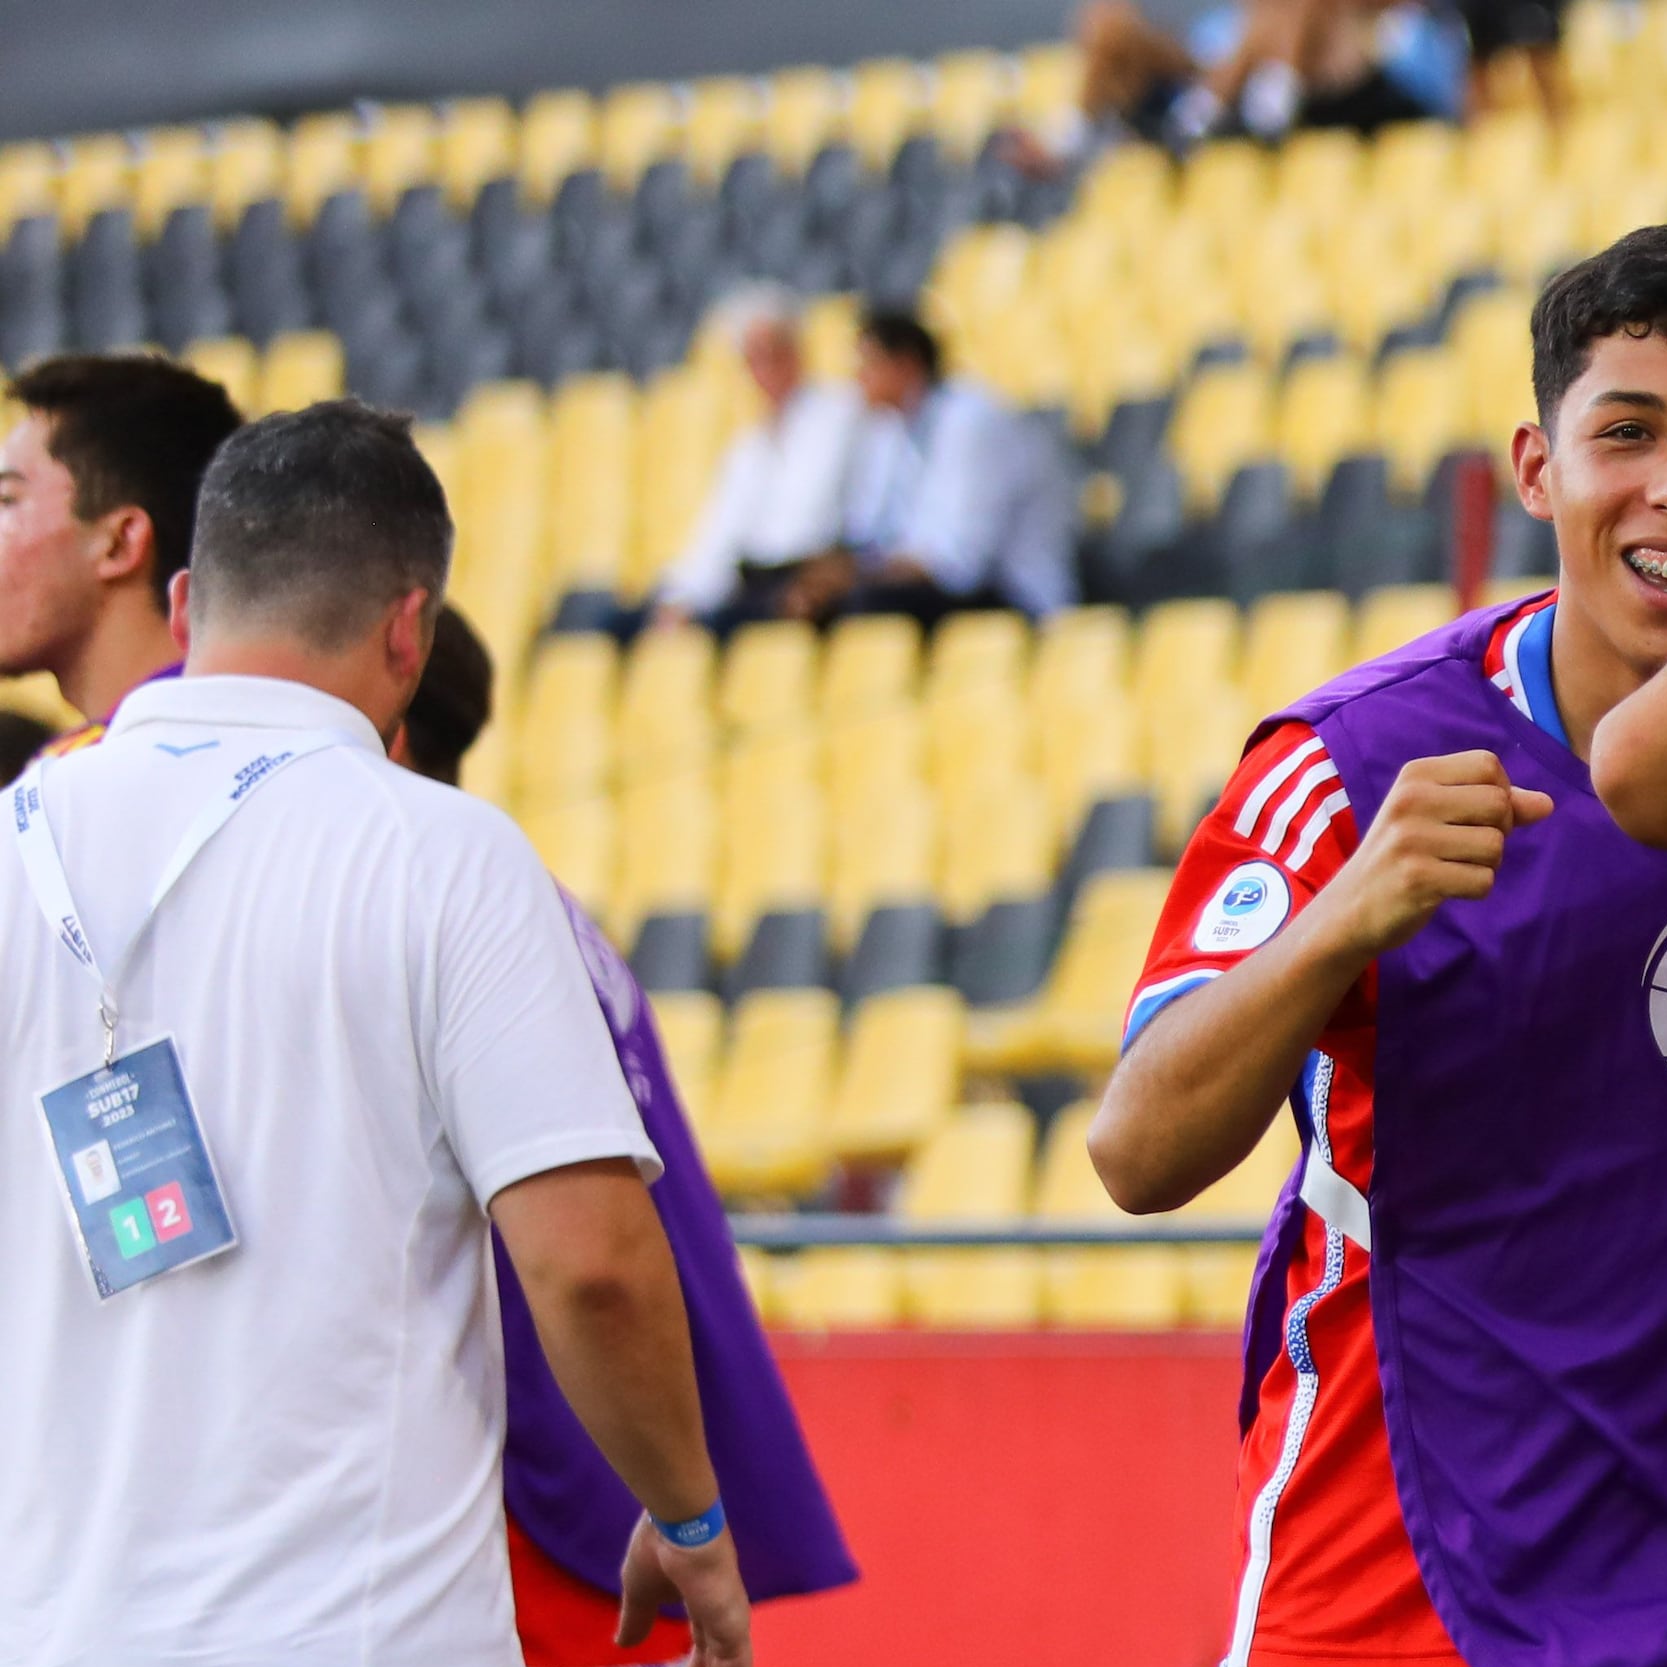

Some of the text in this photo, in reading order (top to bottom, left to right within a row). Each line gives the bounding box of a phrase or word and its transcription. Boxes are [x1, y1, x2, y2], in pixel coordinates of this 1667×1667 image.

[1212, 926, 1240, 936] SUB17
[87, 1083, 140, 1119] SUB17
[102, 1104, 136, 1127] 2023
[123, 1199, 181, 1241] 1 2
